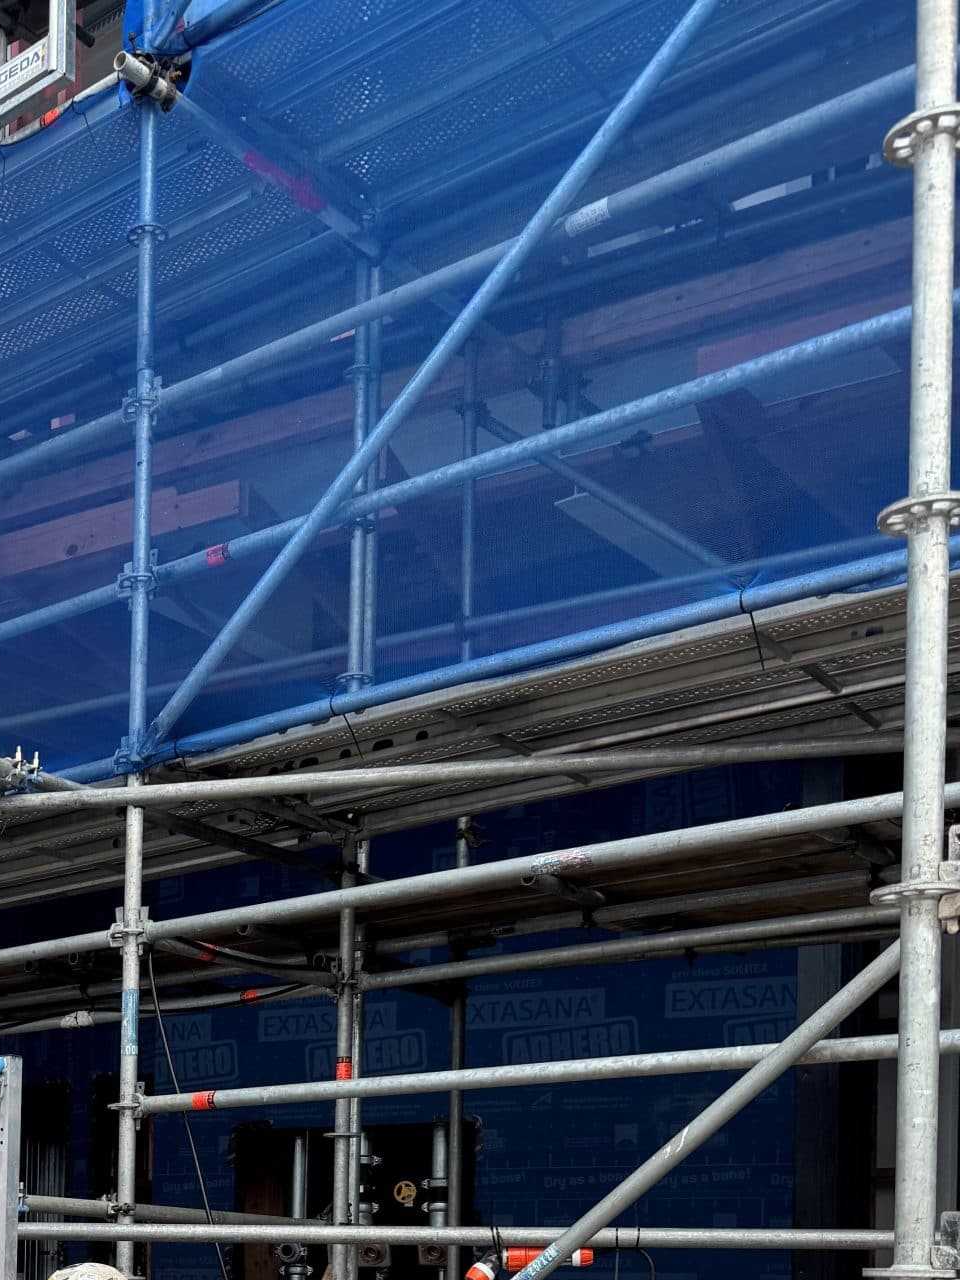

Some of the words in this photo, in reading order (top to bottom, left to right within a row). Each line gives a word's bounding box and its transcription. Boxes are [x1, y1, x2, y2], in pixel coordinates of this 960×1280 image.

[467, 997, 592, 1023] XTASANA
[672, 982, 797, 1012] EXTASAN
[264, 1008, 386, 1036] EXTASA
